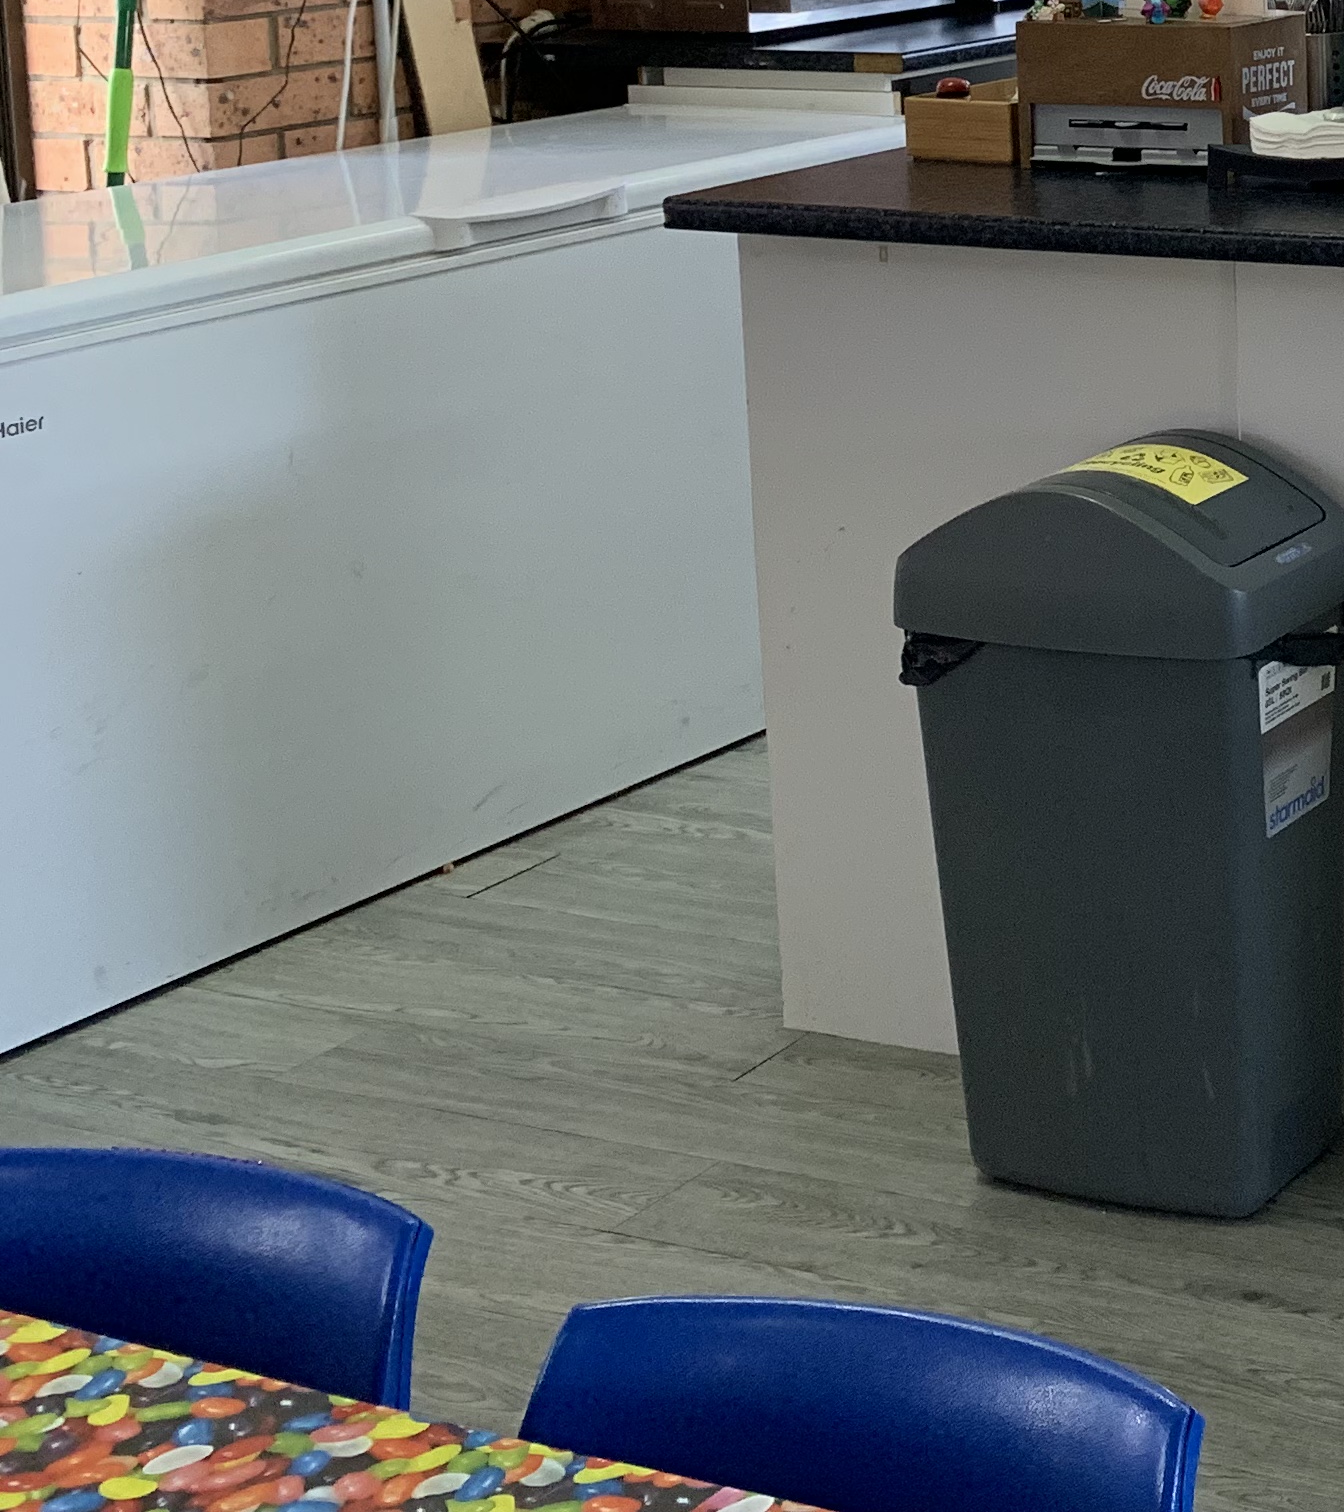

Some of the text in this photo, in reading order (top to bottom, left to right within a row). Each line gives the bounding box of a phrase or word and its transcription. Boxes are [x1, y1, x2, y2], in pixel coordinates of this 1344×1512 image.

[1253, 46, 1285, 61] ENJOY IT
[1241, 59, 1296, 94] PERFECT
[1251, 94, 1271, 108] EVERY
